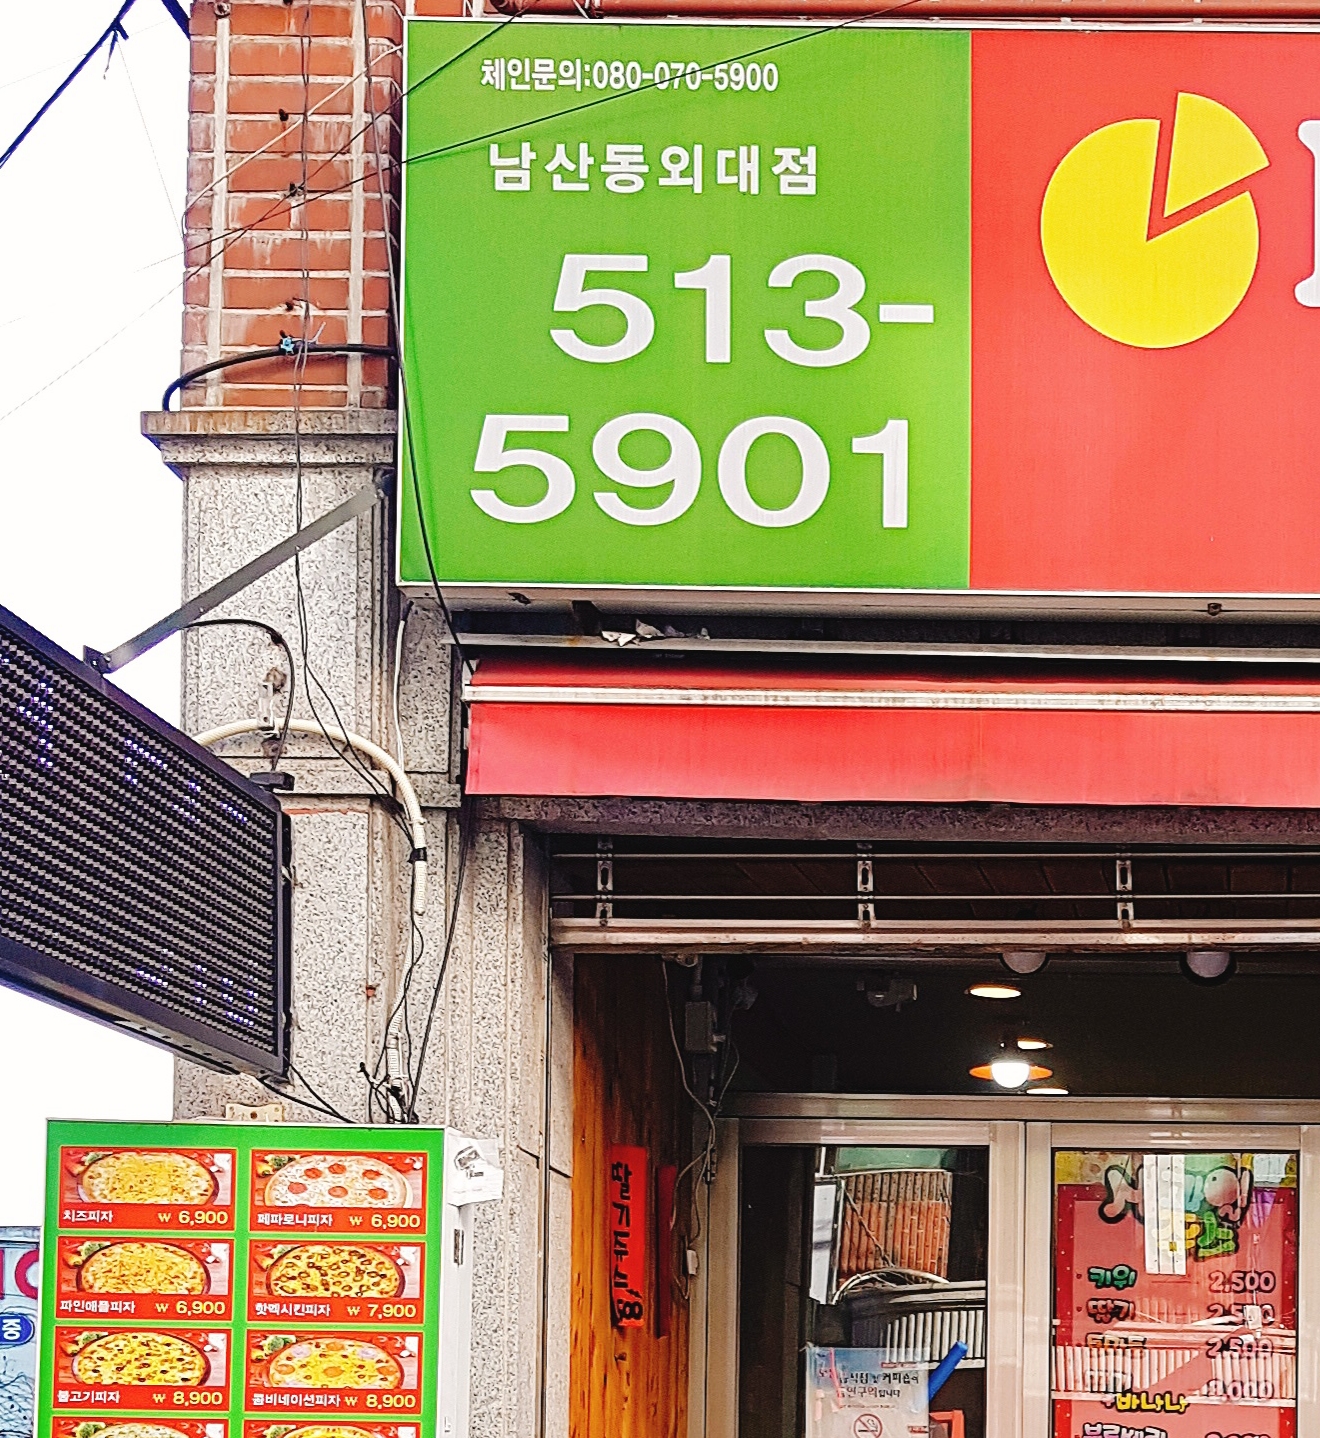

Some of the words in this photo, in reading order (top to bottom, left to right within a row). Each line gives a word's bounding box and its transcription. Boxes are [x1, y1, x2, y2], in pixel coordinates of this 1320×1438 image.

[488, 142, 818, 195] 남산동외대점
[549, 253, 934, 367] 513-
[469, 412, 909, 528] 5901
[63, 1209, 113, 1223] 치즈피자
[178, 1210, 229, 1226] 6,900
[371, 1214, 421, 1229] 6,900
[1088, 1264, 1137, 1291] 키위
[1208, 1270, 1276, 1294] 2,500
[175, 1301, 226, 1316] 6,900
[367, 1304, 417, 1319] 7,900
[173, 1391, 223, 1406] 8,900
[366, 1394, 416, 1409] 8,900
